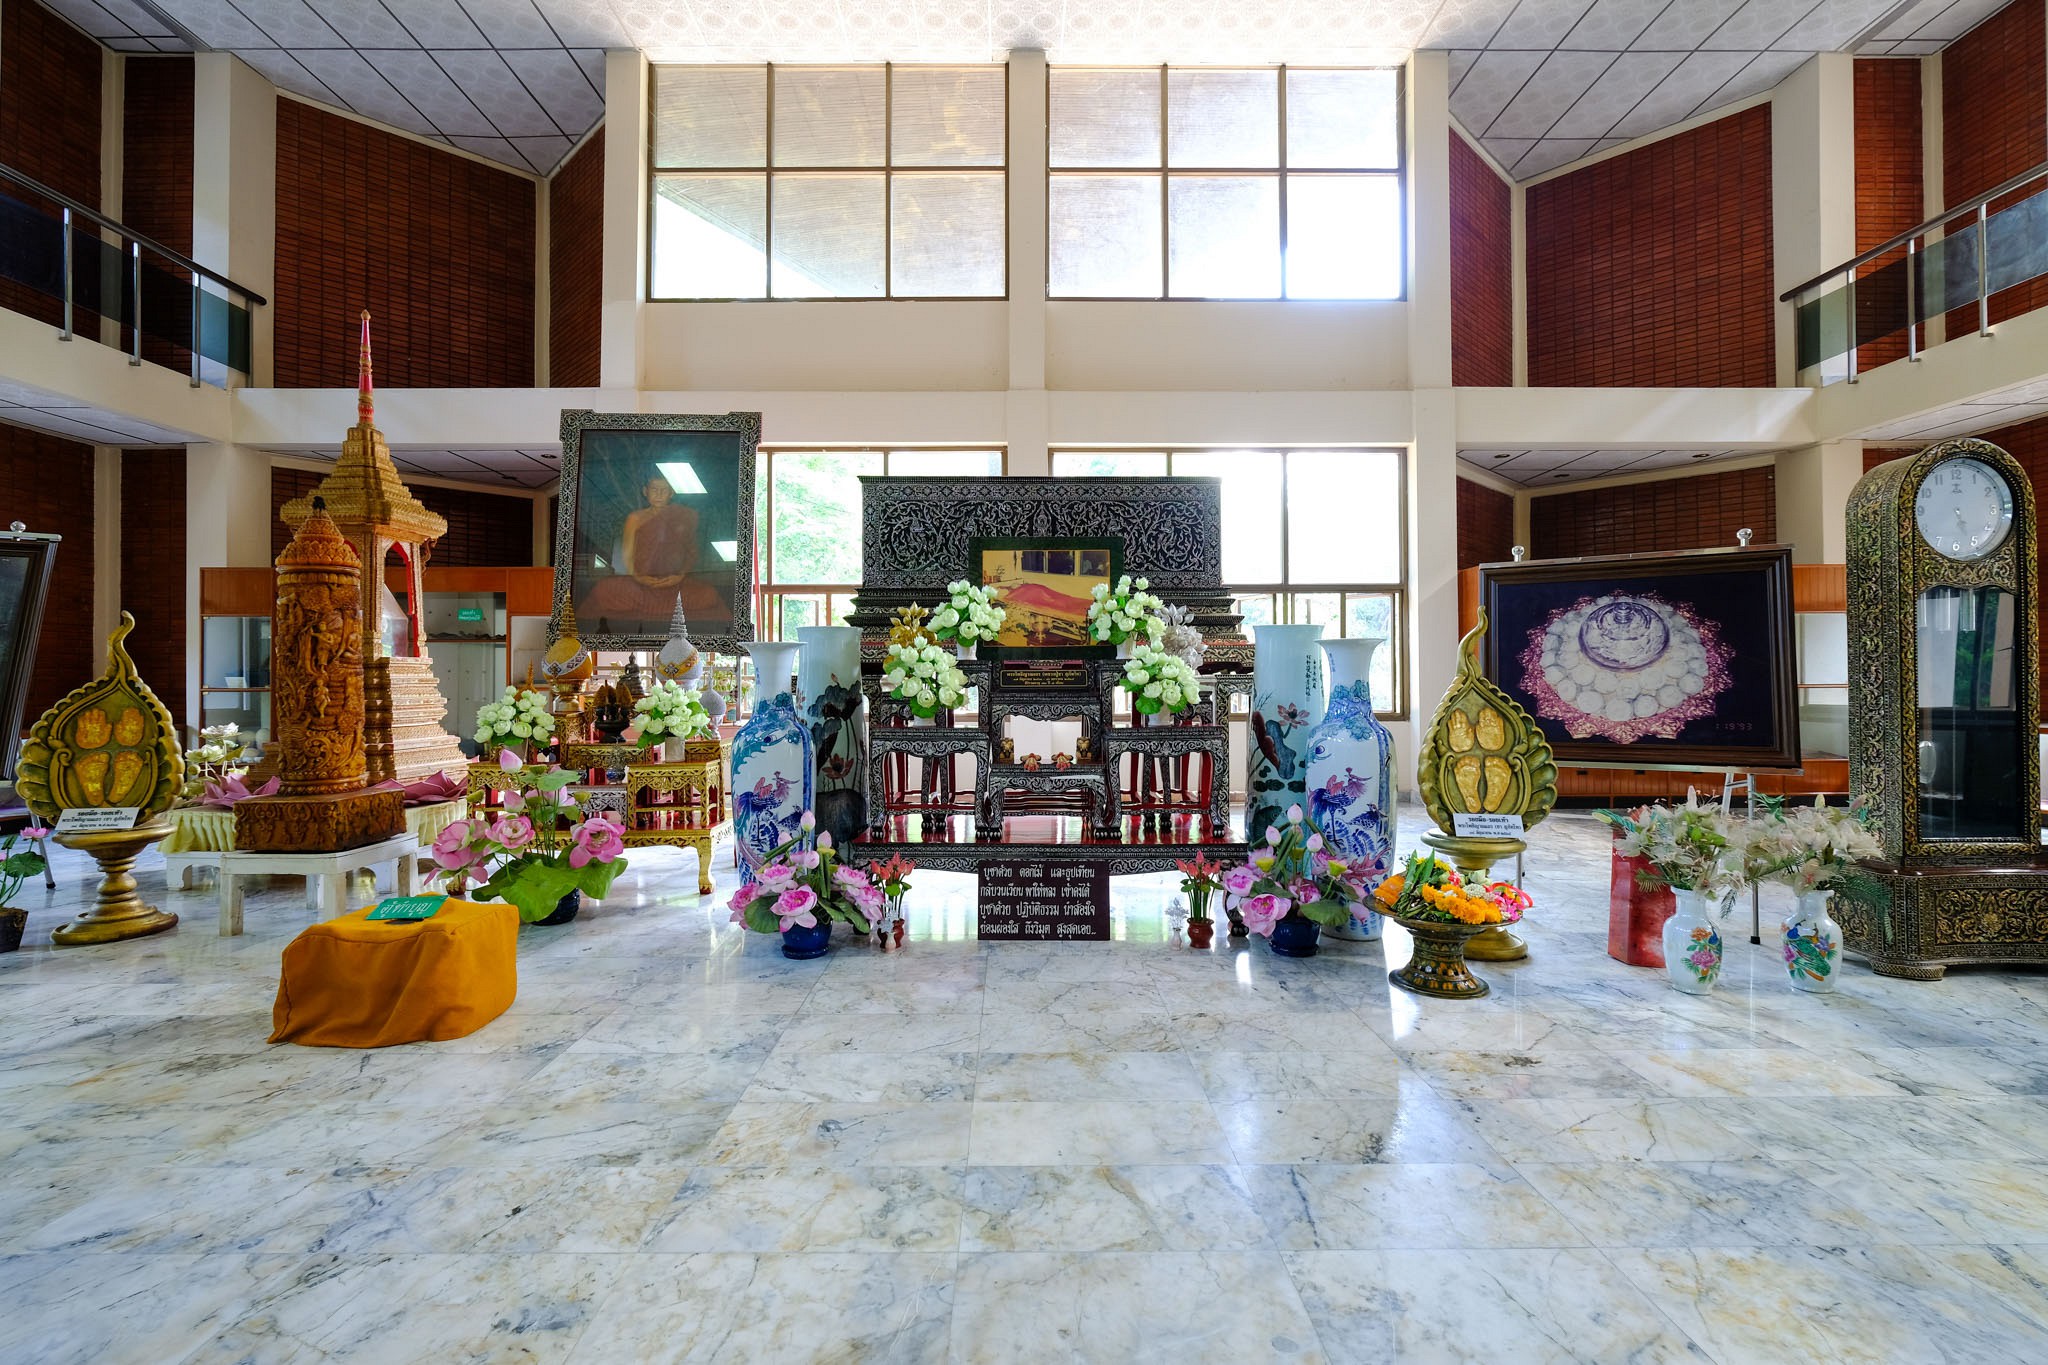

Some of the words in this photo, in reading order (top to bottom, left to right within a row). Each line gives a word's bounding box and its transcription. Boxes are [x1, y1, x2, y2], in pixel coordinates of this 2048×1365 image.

[1951, 469, 1961, 480] 12
[1972, 474, 1976, 484] 1
[1935, 475, 1943, 485] 11
[1921, 488, 1931, 498] 10
[1984, 487, 1992, 497] 2
[1917, 506, 1924, 516] 9
[1990, 505, 1997, 515] 3
[1936, 536, 1943, 547] 7
[1953, 541, 1960, 551] 6
[1971, 536, 1977, 546] 5
[984, 864, 1012, 880] บูชาด้วย
[1019, 864, 1043, 878] ดอกไม้
[1050, 865, 1095, 881] และธูปเทียน
[980, 882, 1024, 897] กลับวนเวียน
[380, 901, 432, 917] ตู้ทำบุญ
[980, 900, 1011, 919] บูชาด้วย
[1016, 901, 1060, 919] ปฏิบัติธรรม
[1064, 900, 1096, 916] นำส่องใจ
[980, 920, 1020, 935] ย่อมผ่องใส
